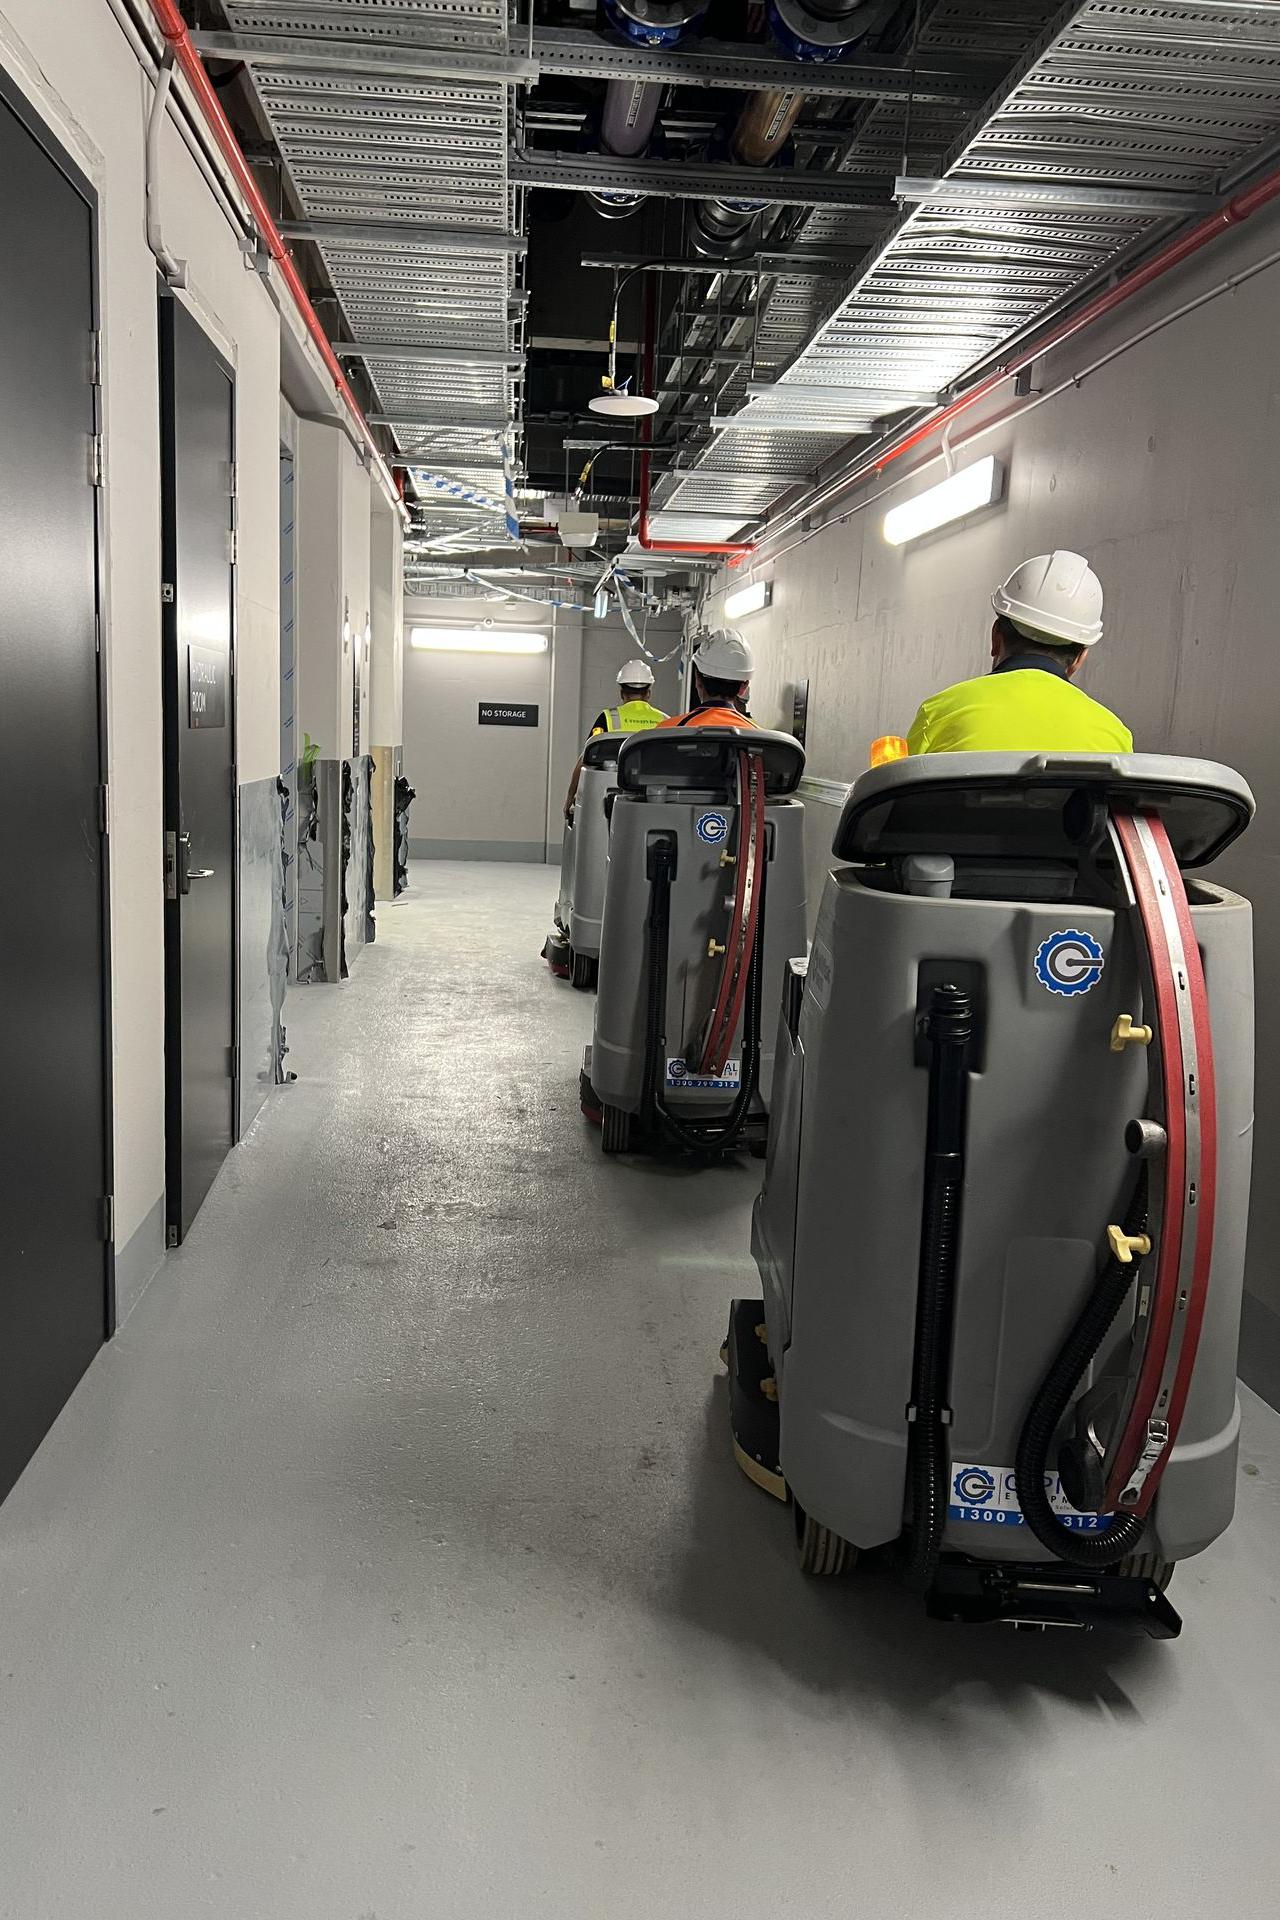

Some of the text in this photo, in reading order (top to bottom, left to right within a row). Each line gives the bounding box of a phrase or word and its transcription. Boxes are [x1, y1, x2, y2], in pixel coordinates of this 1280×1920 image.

[494, 710, 526, 718] STORAGE
[958, 1508, 1006, 1523] 1300
[1063, 1516, 1098, 1529] 312
